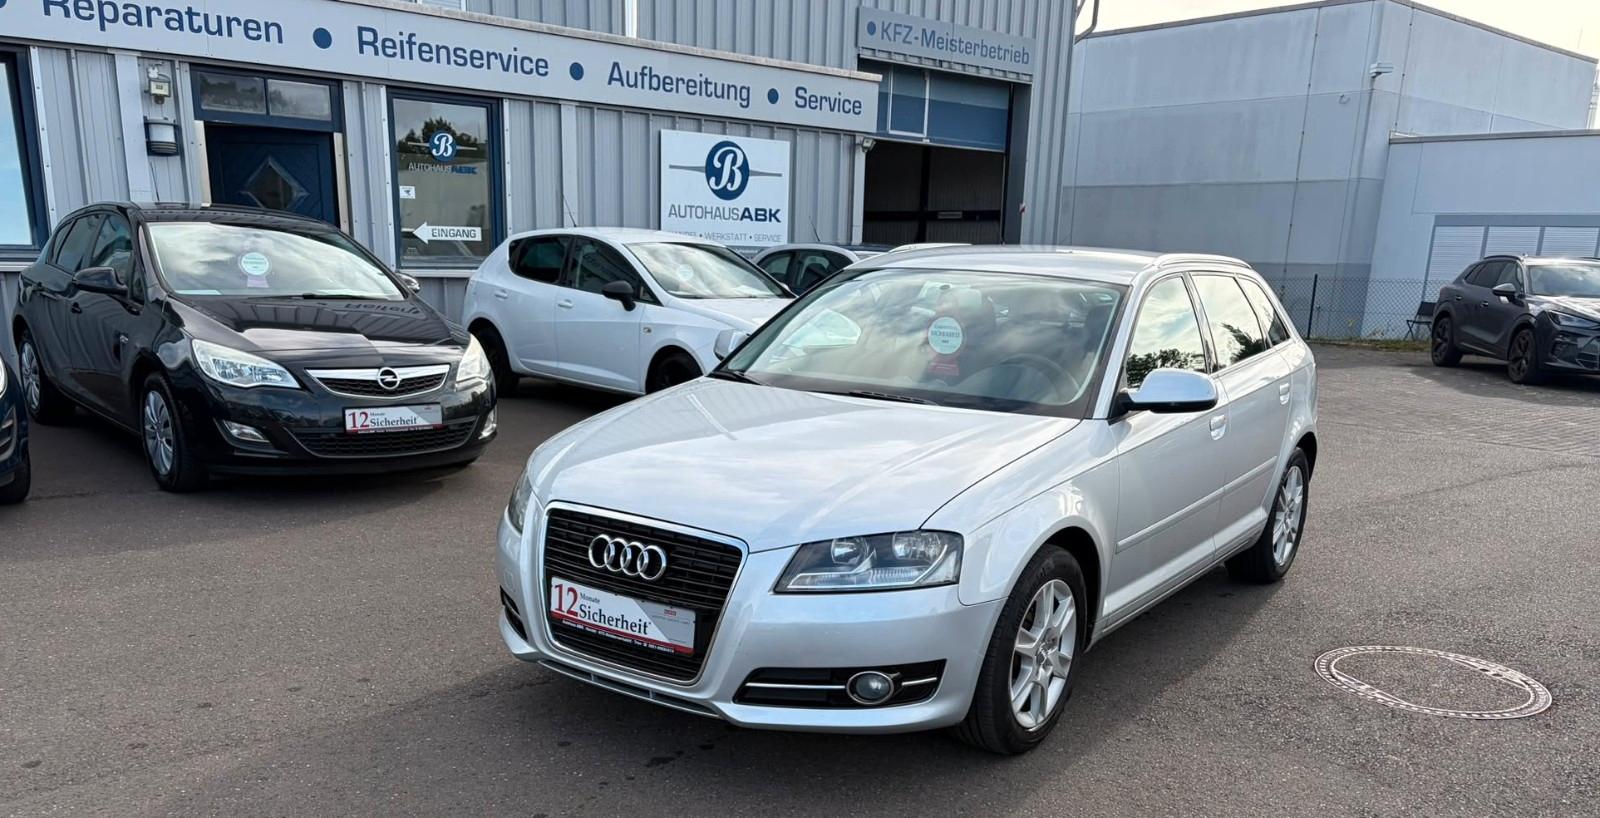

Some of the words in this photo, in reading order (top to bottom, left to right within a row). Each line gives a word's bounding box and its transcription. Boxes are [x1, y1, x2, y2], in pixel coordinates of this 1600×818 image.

[881, 21, 1030, 65] KFZ-Meisterbetrieb
[357, 25, 549, 77] Reifenservice
[607, 61, 751, 109] Aufbereitung
[794, 86, 862, 116] Service
[709, 146, 744, 191] B
[431, 228, 477, 239] EINGANG
[704, 231, 747, 241] WERKSTATT
[753, 233, 782, 243] SERVICE
[348, 411, 369, 429] 12
[370, 416, 418, 427] Sicherheit
[554, 583, 579, 618] 12
[579, 592, 601, 603] Monate
[579, 603, 650, 635] Sicherheit
